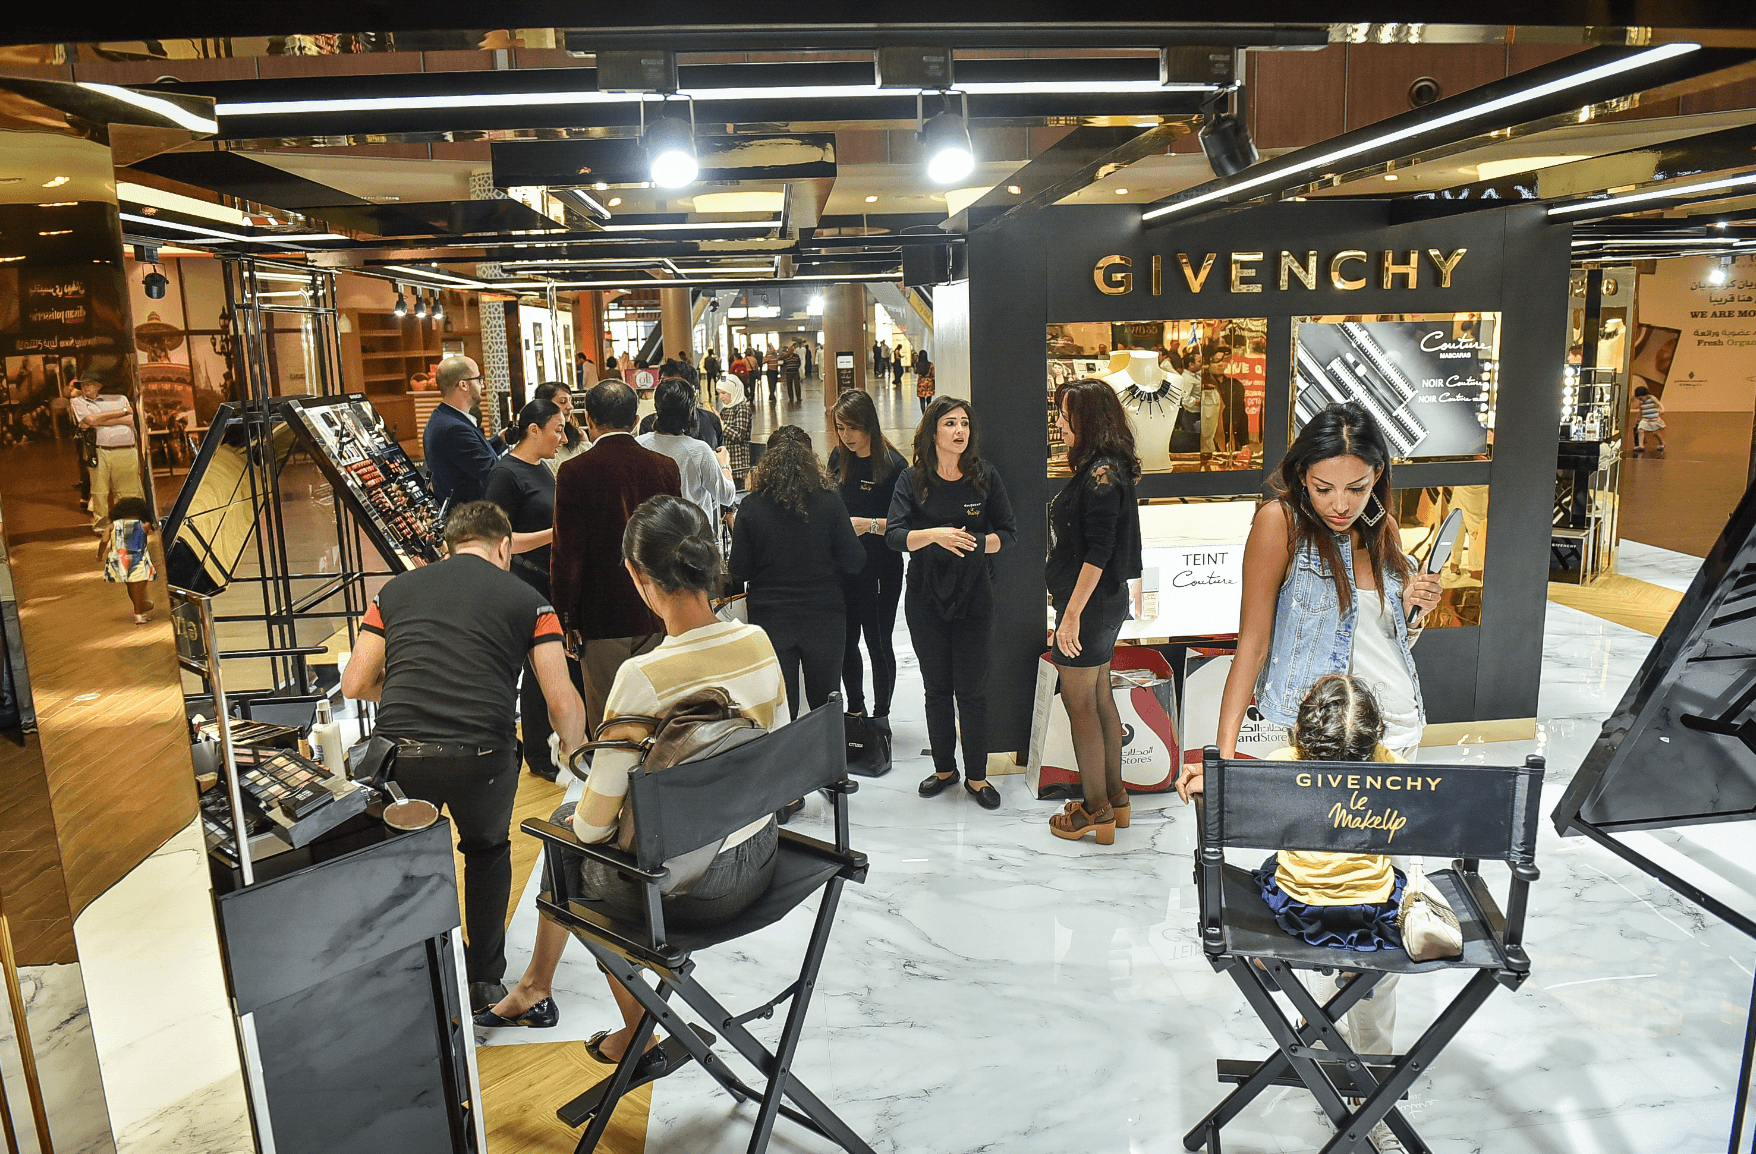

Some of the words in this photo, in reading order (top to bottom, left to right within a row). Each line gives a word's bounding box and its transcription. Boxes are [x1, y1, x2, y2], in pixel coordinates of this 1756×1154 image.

[1093, 248, 1468, 296] GIVENCHY
[1710, 310, 1735, 318] ARE
[1737, 309, 1756, 318] MO
[1420, 330, 1491, 352] Couture
[1422, 379, 1444, 388] NOIR
[1418, 395, 1437, 403] NOIR
[1438, 391, 1471, 403] Couture
[1181, 552, 1229, 566] TEINT
[1172, 570, 1238, 588] Couture
[1237, 733, 1288, 743] andStore
[1295, 773, 1442, 791] GIVENCHY
